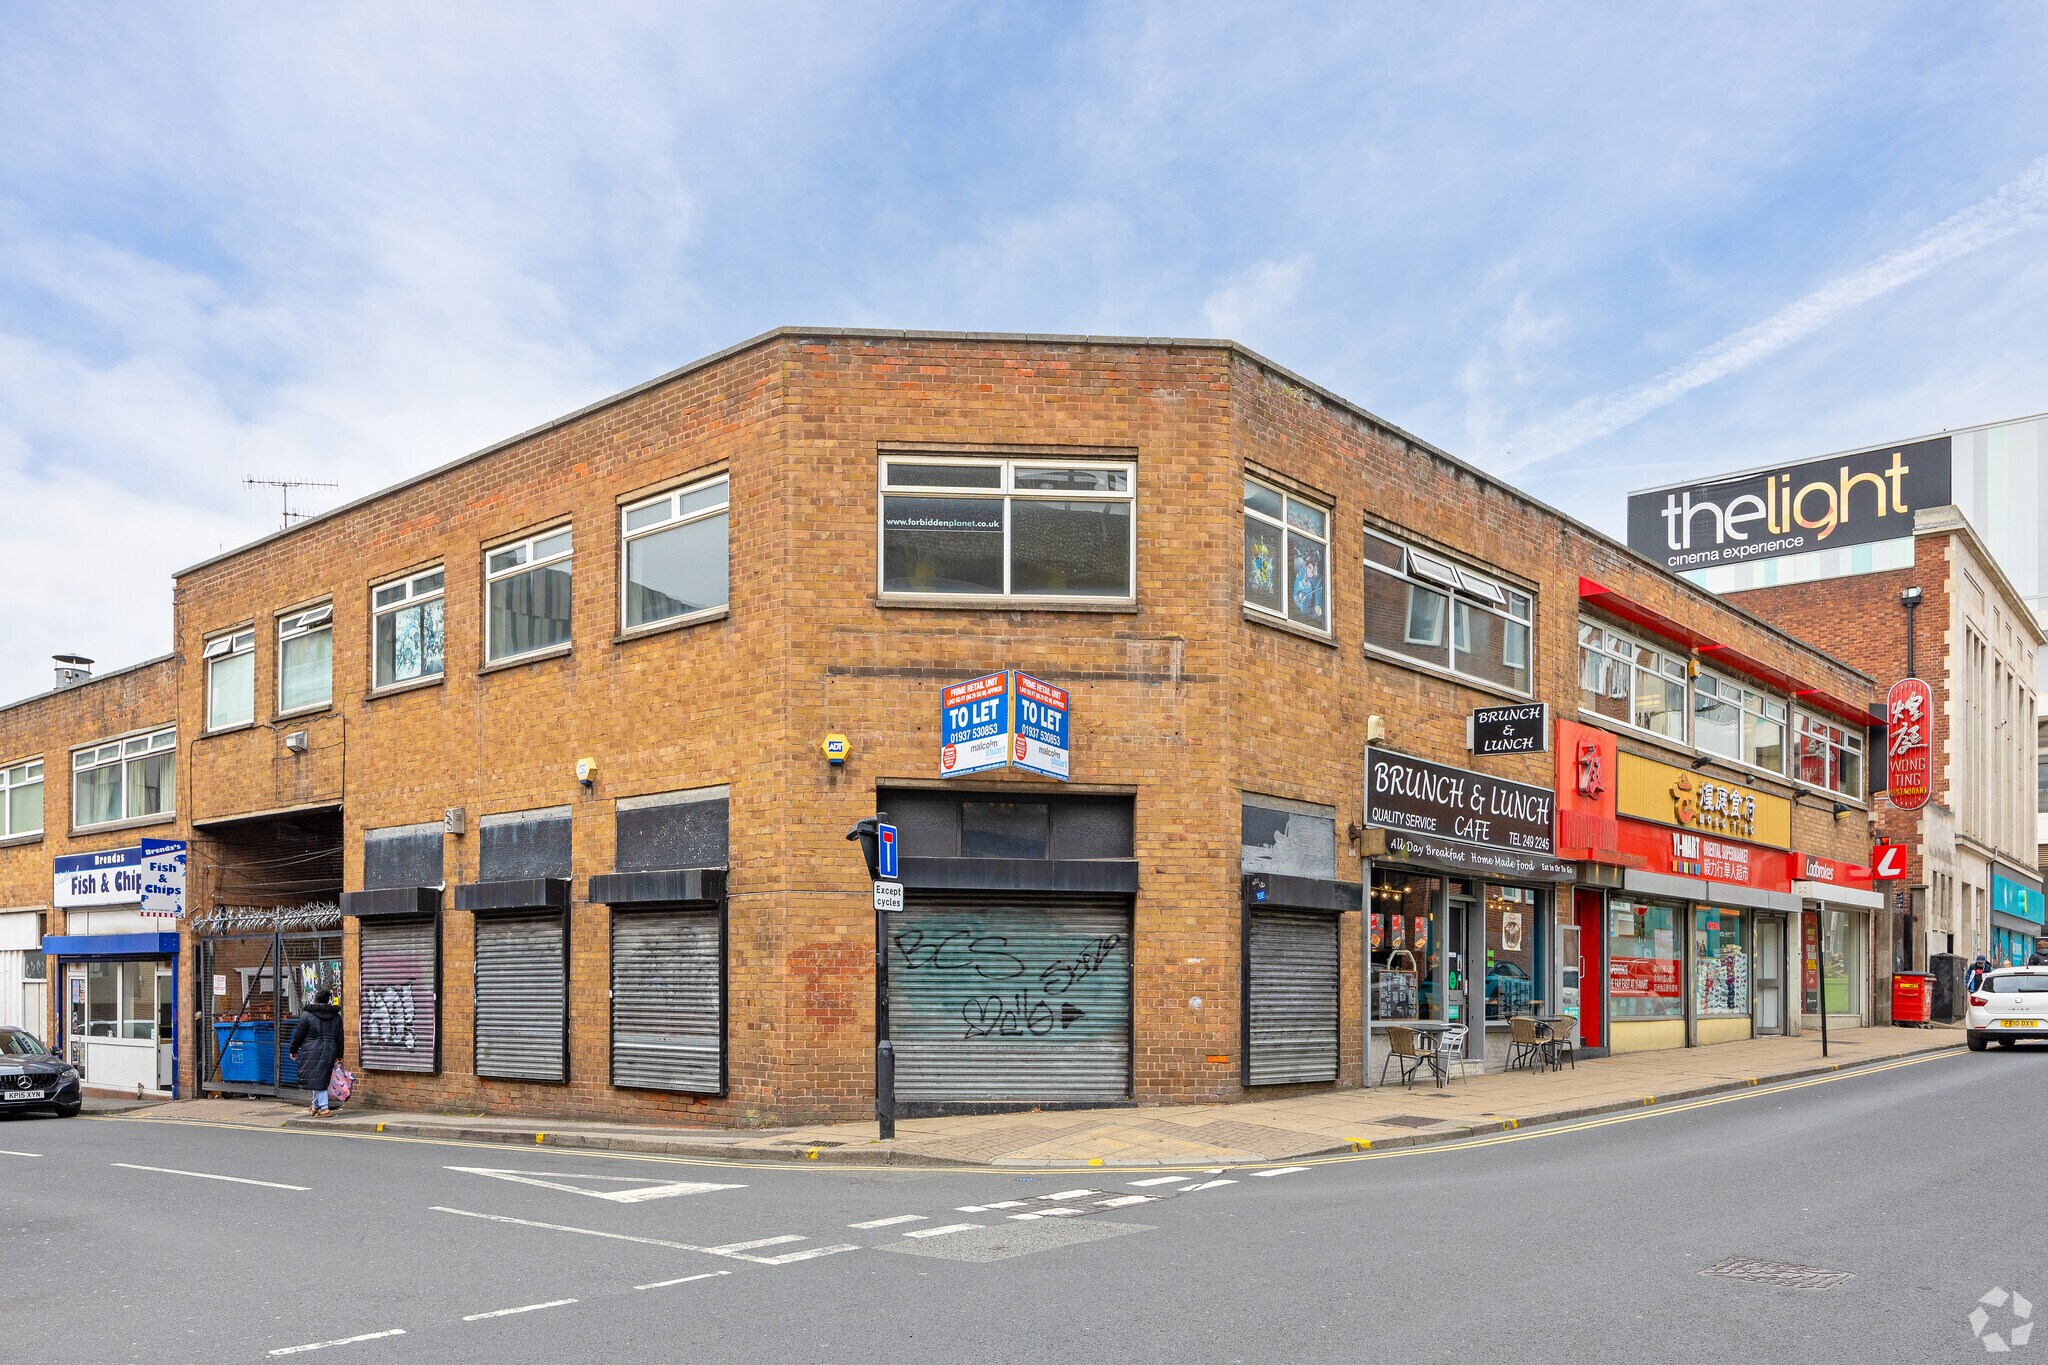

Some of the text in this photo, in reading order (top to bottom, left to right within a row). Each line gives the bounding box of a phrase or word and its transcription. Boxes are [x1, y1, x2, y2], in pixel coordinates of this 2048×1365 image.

[1661, 452, 1909, 551] thelight
[886, 517, 1000, 529] www.forbiddenplanet.co.uk
[1668, 536, 1804, 567] cinema experience
[950, 677, 998, 697] PRIME RETAIL UNIT
[1022, 678, 1036, 690] PRIME
[1037, 683, 1051, 696] RETAIL
[949, 698, 1000, 730] TO LET
[1021, 698, 1062, 732] TO LET
[1478, 706, 1541, 723] BRUNCH
[950, 723, 998, 744] 01937 530853
[1021, 723, 1039, 738] 01937
[1502, 724, 1515, 736] &
[828, 742, 842, 751] ADT
[970, 740, 998, 753] malcolm
[985, 745, 1006, 757] stuart
[1484, 737, 1534, 751] LUNCH
[1038, 746, 1061, 759] malcolm
[1051, 757, 1068, 768] stuart
[1890, 757, 1926, 772] WONG
[1895, 773, 1921, 786] TING
[1374, 762, 1550, 825] BRUNCH & LUNCH
[1372, 807, 1437, 831] QUALITY SERVICE
[1454, 816, 1491, 842] CAFE
[1509, 831, 1550, 851] TEL 249 2245
[1672, 832, 1749, 864] YI-MART ORIENTAL SUPERMARKET
[145, 844, 181, 856] Brenda's
[1390, 837, 1405, 850] All
[1406, 841, 1424, 857] Day
[1426, 844, 1466, 861] Breakfast
[1470, 852, 1494, 866] Home
[1494, 855, 1517, 869] Made
[1517, 857, 1536, 871] Food
[1541, 863, 1550, 871] Eat
[94, 853, 125, 866] Brendas
[149, 862, 177, 873] Fish
[1806, 859, 1834, 881] Ladbrokes
[71, 873, 96, 895] Fish
[100, 872, 110, 893] &
[115, 869, 142, 895] Chip
[158, 874, 168, 883] &
[144, 884, 182, 896] Chips
[876, 885, 901, 896] Except
[877, 898, 900, 907] cycles
